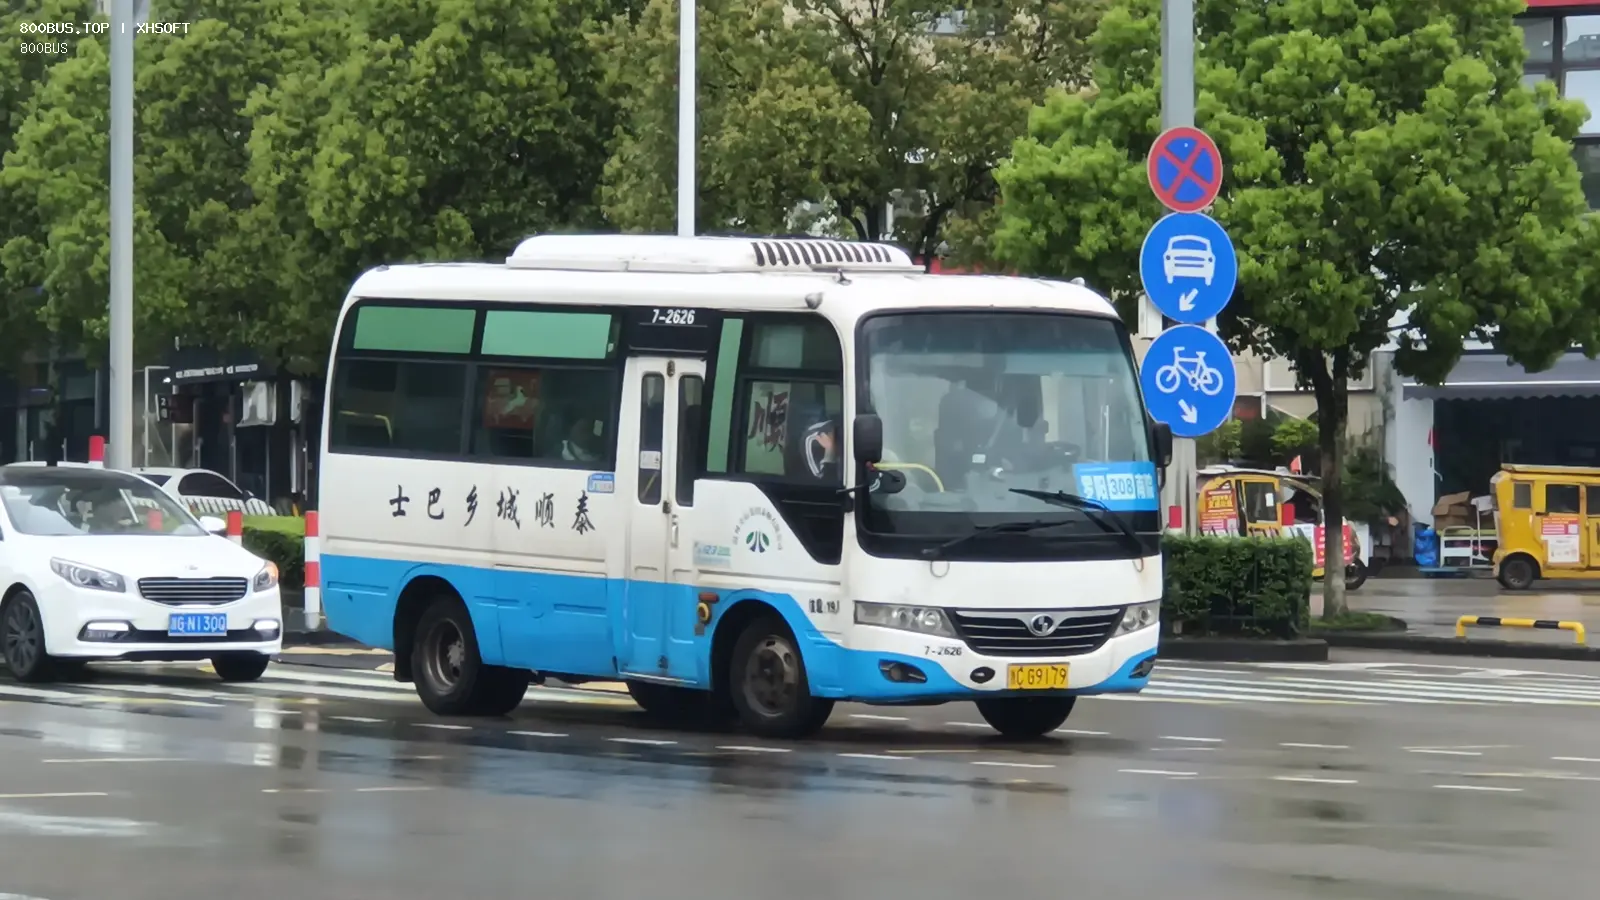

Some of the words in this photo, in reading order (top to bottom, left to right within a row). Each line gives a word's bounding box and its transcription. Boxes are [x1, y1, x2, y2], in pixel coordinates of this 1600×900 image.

[651, 308, 696, 325] 7-2626
[1110, 478, 1134, 496] 308
[923, 645, 963, 657] 7-2626
